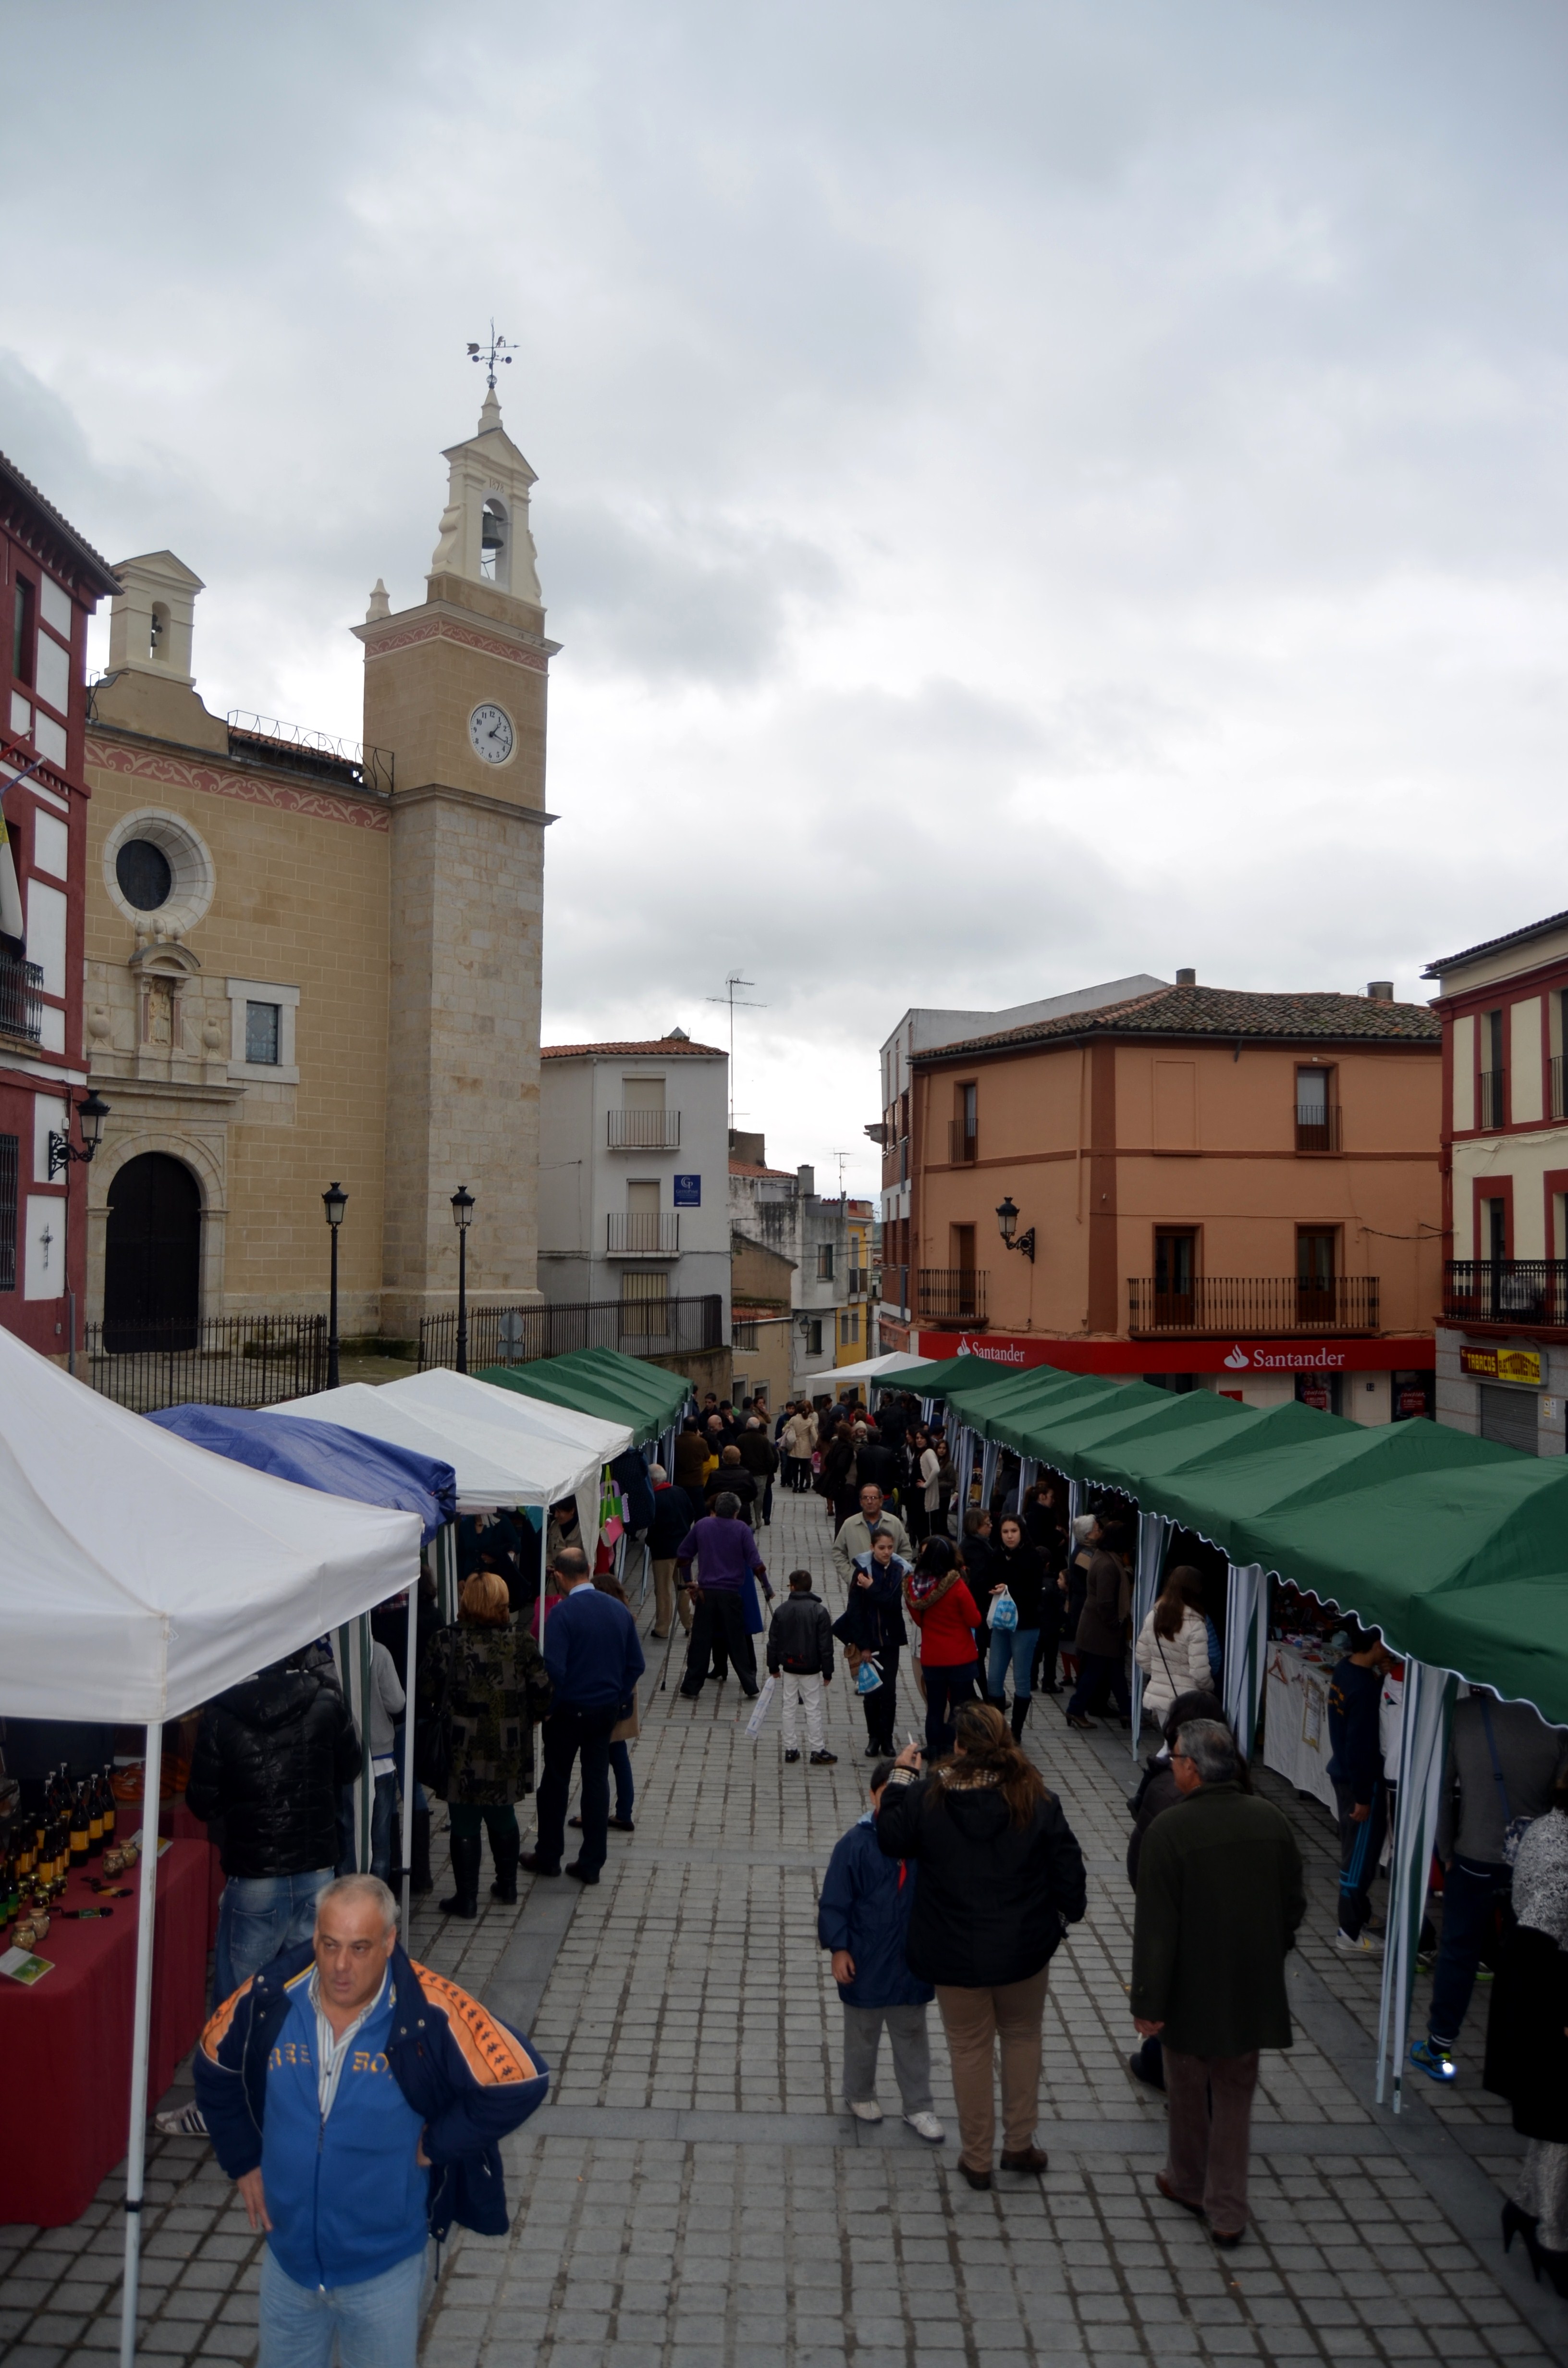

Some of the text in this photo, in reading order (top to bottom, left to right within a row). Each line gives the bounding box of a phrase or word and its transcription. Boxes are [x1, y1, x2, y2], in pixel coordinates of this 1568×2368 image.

[972, 1342, 1025, 1362] Santander
[1253, 1347, 1345, 1367] Santander
[1467, 1353, 1496, 1372] TABACOS
